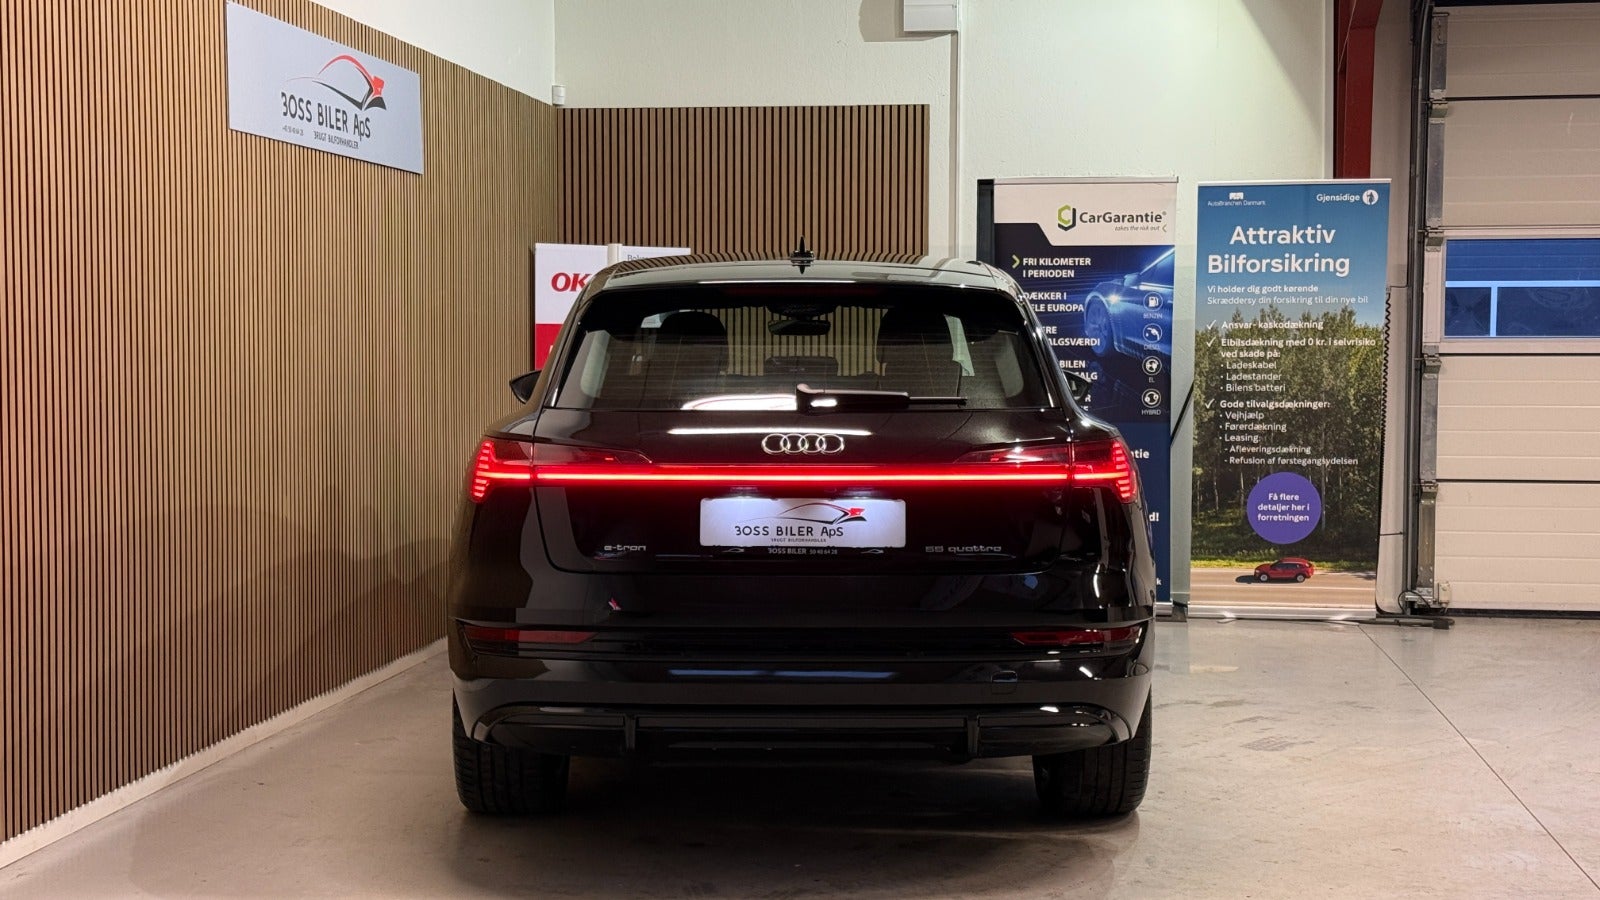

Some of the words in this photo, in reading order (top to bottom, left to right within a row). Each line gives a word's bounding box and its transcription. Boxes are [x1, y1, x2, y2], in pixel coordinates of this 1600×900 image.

[317, 102, 349, 133] BILER
[353, 113, 371, 141] ApS
[1316, 193, 1360, 202] Gjensidige
[1229, 224, 1336, 245] Attraktiv
[1023, 257, 1037, 266] FRI
[1039, 257, 1091, 266] KILOMETER
[1207, 253, 1350, 278] Bilforsikring
[1028, 270, 1075, 278] PERIODEN
[1217, 285, 1245, 293] holder
[1247, 285, 1260, 295] dig
[1262, 285, 1282, 295] godt
[1283, 285, 1319, 293] kørende
[1207, 296, 1256, 305] Skræddersy
[1273, 296, 1313, 305] forsikring
[1340, 297, 1356, 305] nye
[1047, 304, 1085, 312] EUROPA
[1258, 320, 1324, 330] kaskodækning
[1221, 338, 1284, 348] Elbilsdækning
[1286, 338, 1306, 346] med
[1308, 338, 1313, 346] 0
[1315, 338, 1327, 346] kr.
[1333, 338, 1376, 346] selvrisiko
[1221, 350, 1238, 358] ved
[1239, 350, 1265, 358] skade
[1059, 360, 1086, 369] BILEN
[1226, 361, 1277, 370] Ladeskabel
[1225, 373, 1282, 381] Ladestander
[1225, 384, 1253, 392] Bilens
[1254, 383, 1286, 392] batteri
[1220, 401, 1245, 409] Gode
[1225, 411, 1265, 421] Vejhjælp
[1225, 423, 1287, 433] Førerdækning
[1229, 446, 1312, 455] Afleveringsdækning
[1229, 456, 1266, 465] Refusion
[1267, 456, 1276, 464] af
[1277, 456, 1359, 467] førstegangsydelsen
[1268, 493, 1279, 501] Få
[1280, 492, 1300, 501] flere
[1257, 503, 1290, 513] detaljer
[1291, 503, 1305, 511] her
[1257, 513, 1310, 523] forretningen
[776, 526, 813, 537] BILER
[820, 526, 844, 539] ApS
[787, 547, 807, 555] BILER
[947, 545, 1002, 553] quattro
